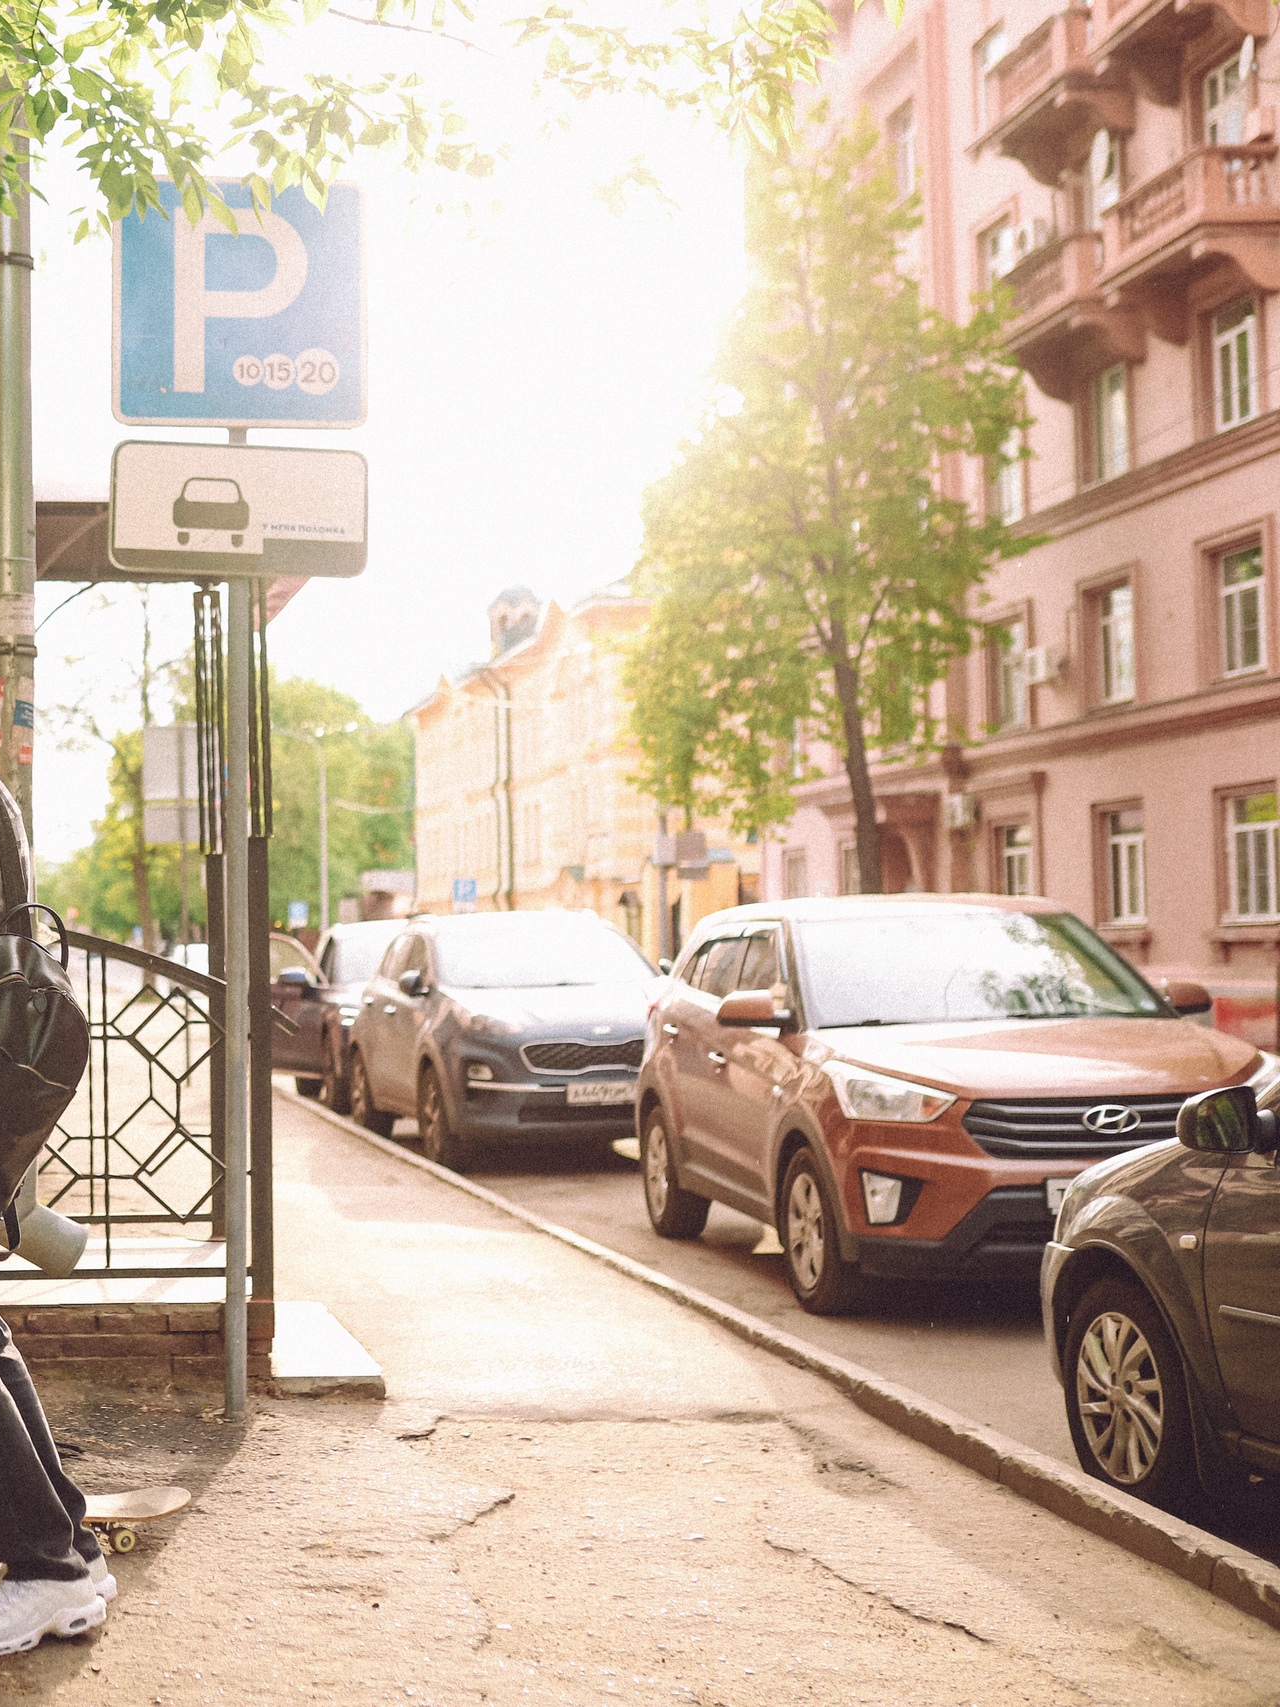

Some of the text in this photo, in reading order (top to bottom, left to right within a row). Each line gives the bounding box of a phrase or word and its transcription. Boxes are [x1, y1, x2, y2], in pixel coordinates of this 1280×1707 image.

[173, 206, 308, 393] P
[238, 361, 336, 384] 10 15 20
